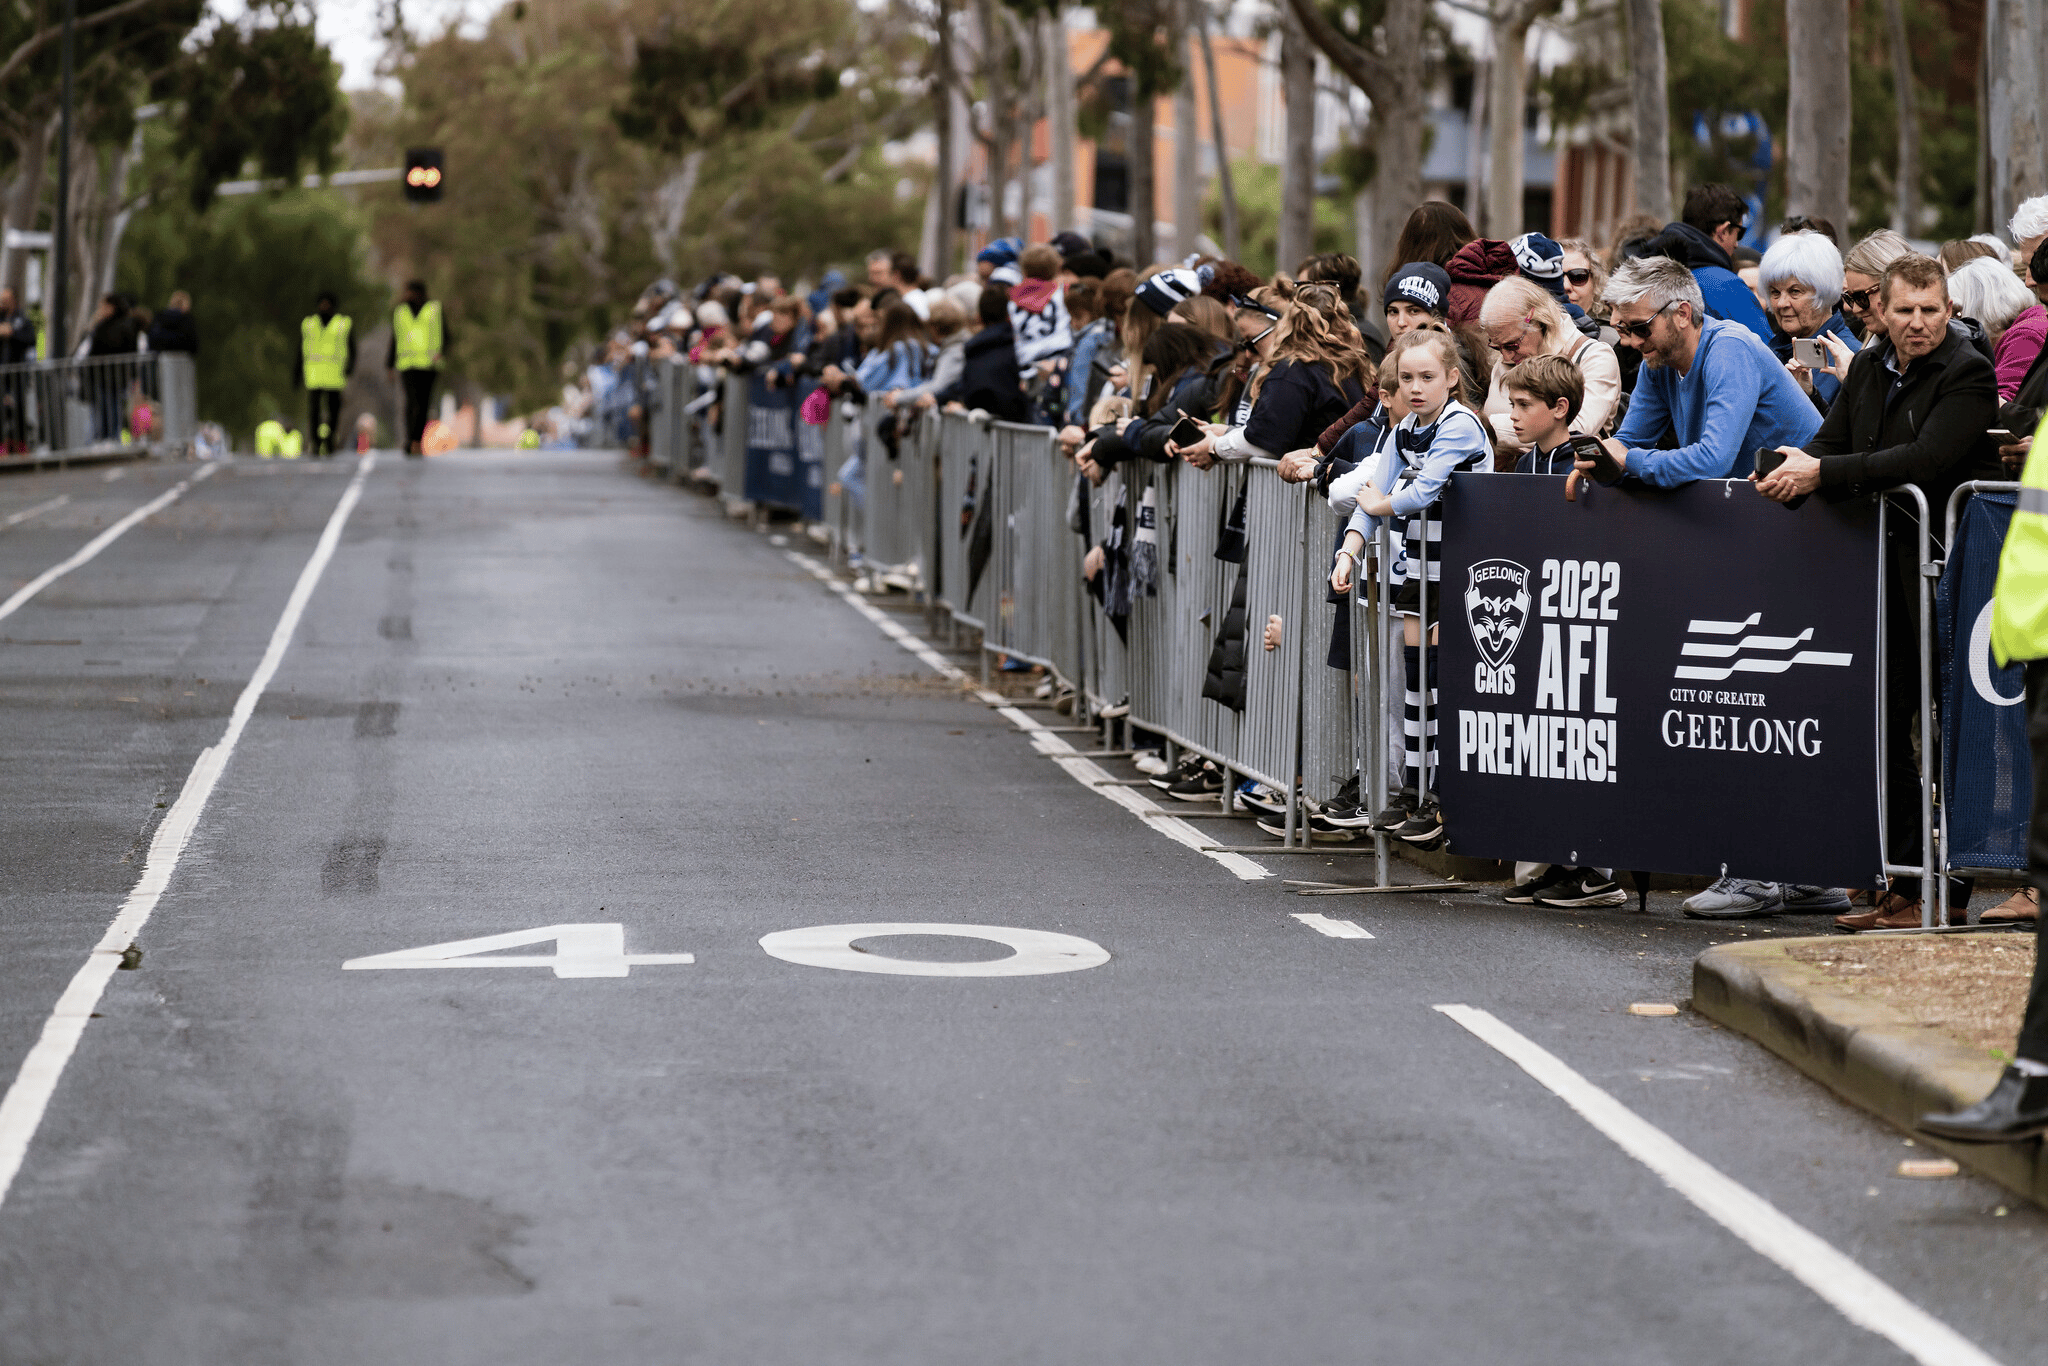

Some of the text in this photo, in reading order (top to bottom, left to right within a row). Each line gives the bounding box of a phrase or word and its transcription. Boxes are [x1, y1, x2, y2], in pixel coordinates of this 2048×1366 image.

[1398, 276, 1440, 305] GEELONG
[1475, 566, 1523, 585] GEELONG
[1540, 558, 1621, 621] 2022
[1475, 661, 1516, 696] CATS
[1536, 623, 1617, 714] AFL
[1670, 688, 1766, 707] CITY OF GREATER
[1458, 709, 1617, 783] PREMIERS!
[1661, 709, 1823, 757] GEELONG
[341, 922, 1112, 979] 40
